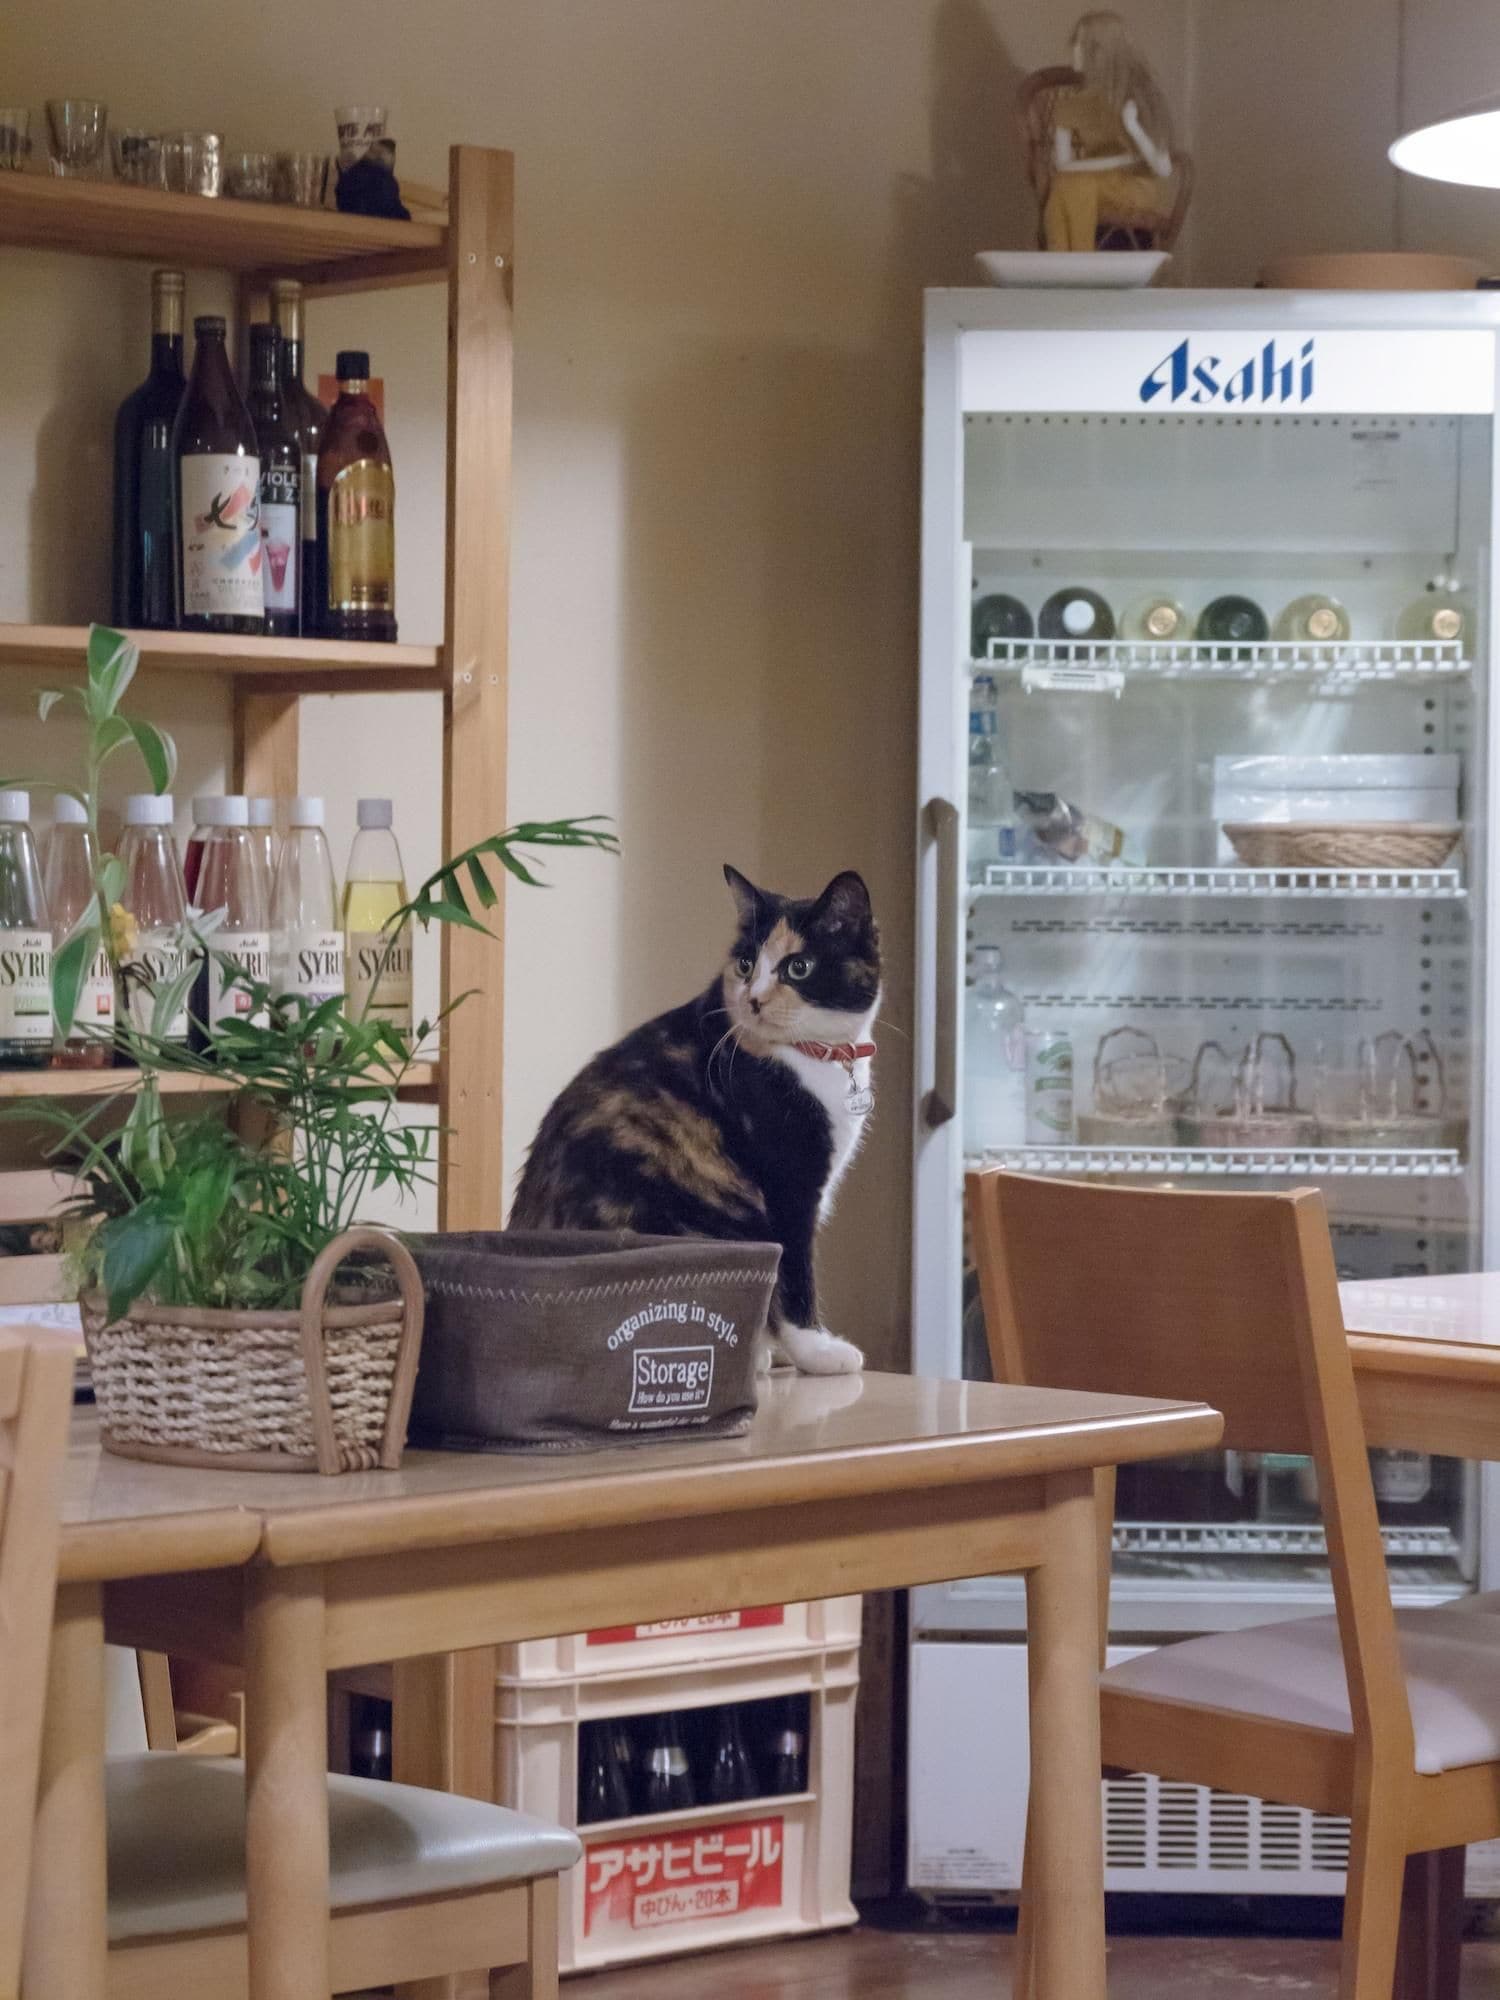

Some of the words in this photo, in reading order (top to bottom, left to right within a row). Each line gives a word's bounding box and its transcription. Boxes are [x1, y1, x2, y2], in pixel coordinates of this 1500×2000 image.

[1140, 338, 1314, 403] Asahi
[1, 951, 51, 985] SYRU
[298, 950, 344, 983] SYRU
[358, 949, 411, 979] SYRU
[608, 1299, 688, 1350] organizing
[691, 1301, 706, 1322] in
[707, 1311, 738, 1348] style
[637, 1356, 709, 1388] Storage
[589, 1826, 781, 1893] アサヒビール
